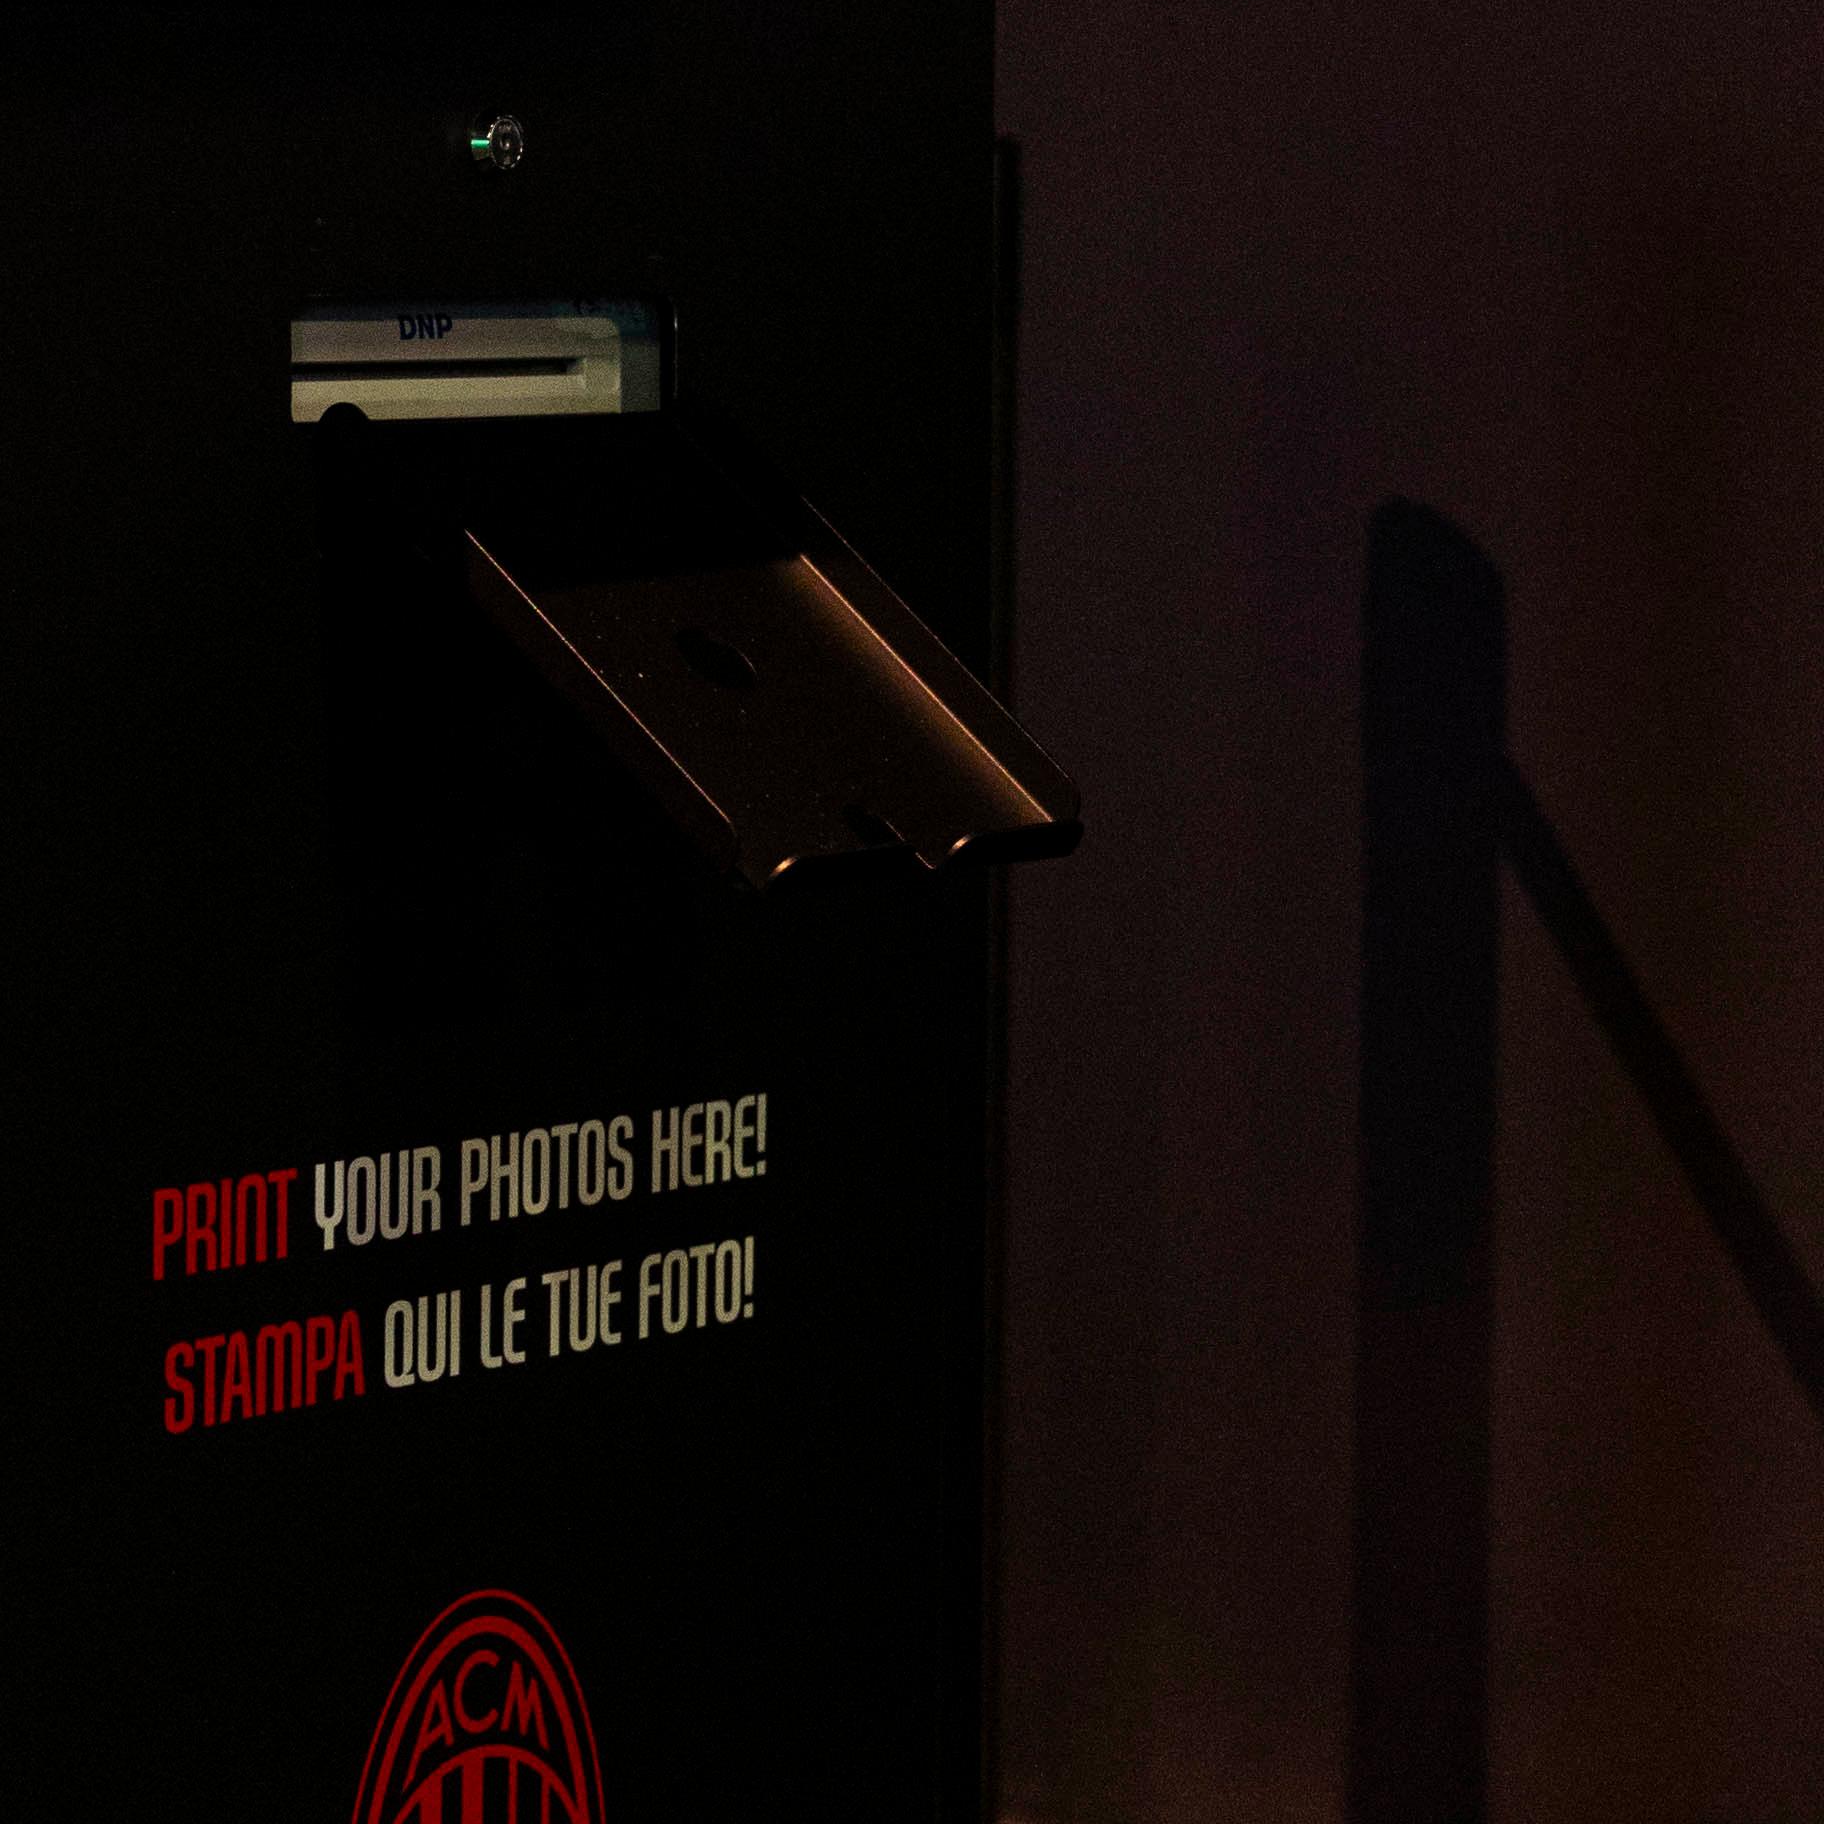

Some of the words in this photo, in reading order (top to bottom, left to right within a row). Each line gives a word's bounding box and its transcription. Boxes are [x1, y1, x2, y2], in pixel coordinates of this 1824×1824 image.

[398, 314, 453, 341] DNP
[152, 1168, 298, 1281] PRINT
[313, 1145, 441, 1251] YOUR
[460, 1115, 633, 1227] PHOTOS
[651, 1092, 768, 1193] HERE!
[163, 1309, 366, 1434] STAMPA
[383, 1288, 461, 1390] QUI
[480, 1277, 526, 1370] LE
[541, 1260, 623, 1358] TUE
[637, 1235, 755, 1340] FOTO!
[403, 1649, 550, 1792] ACM
